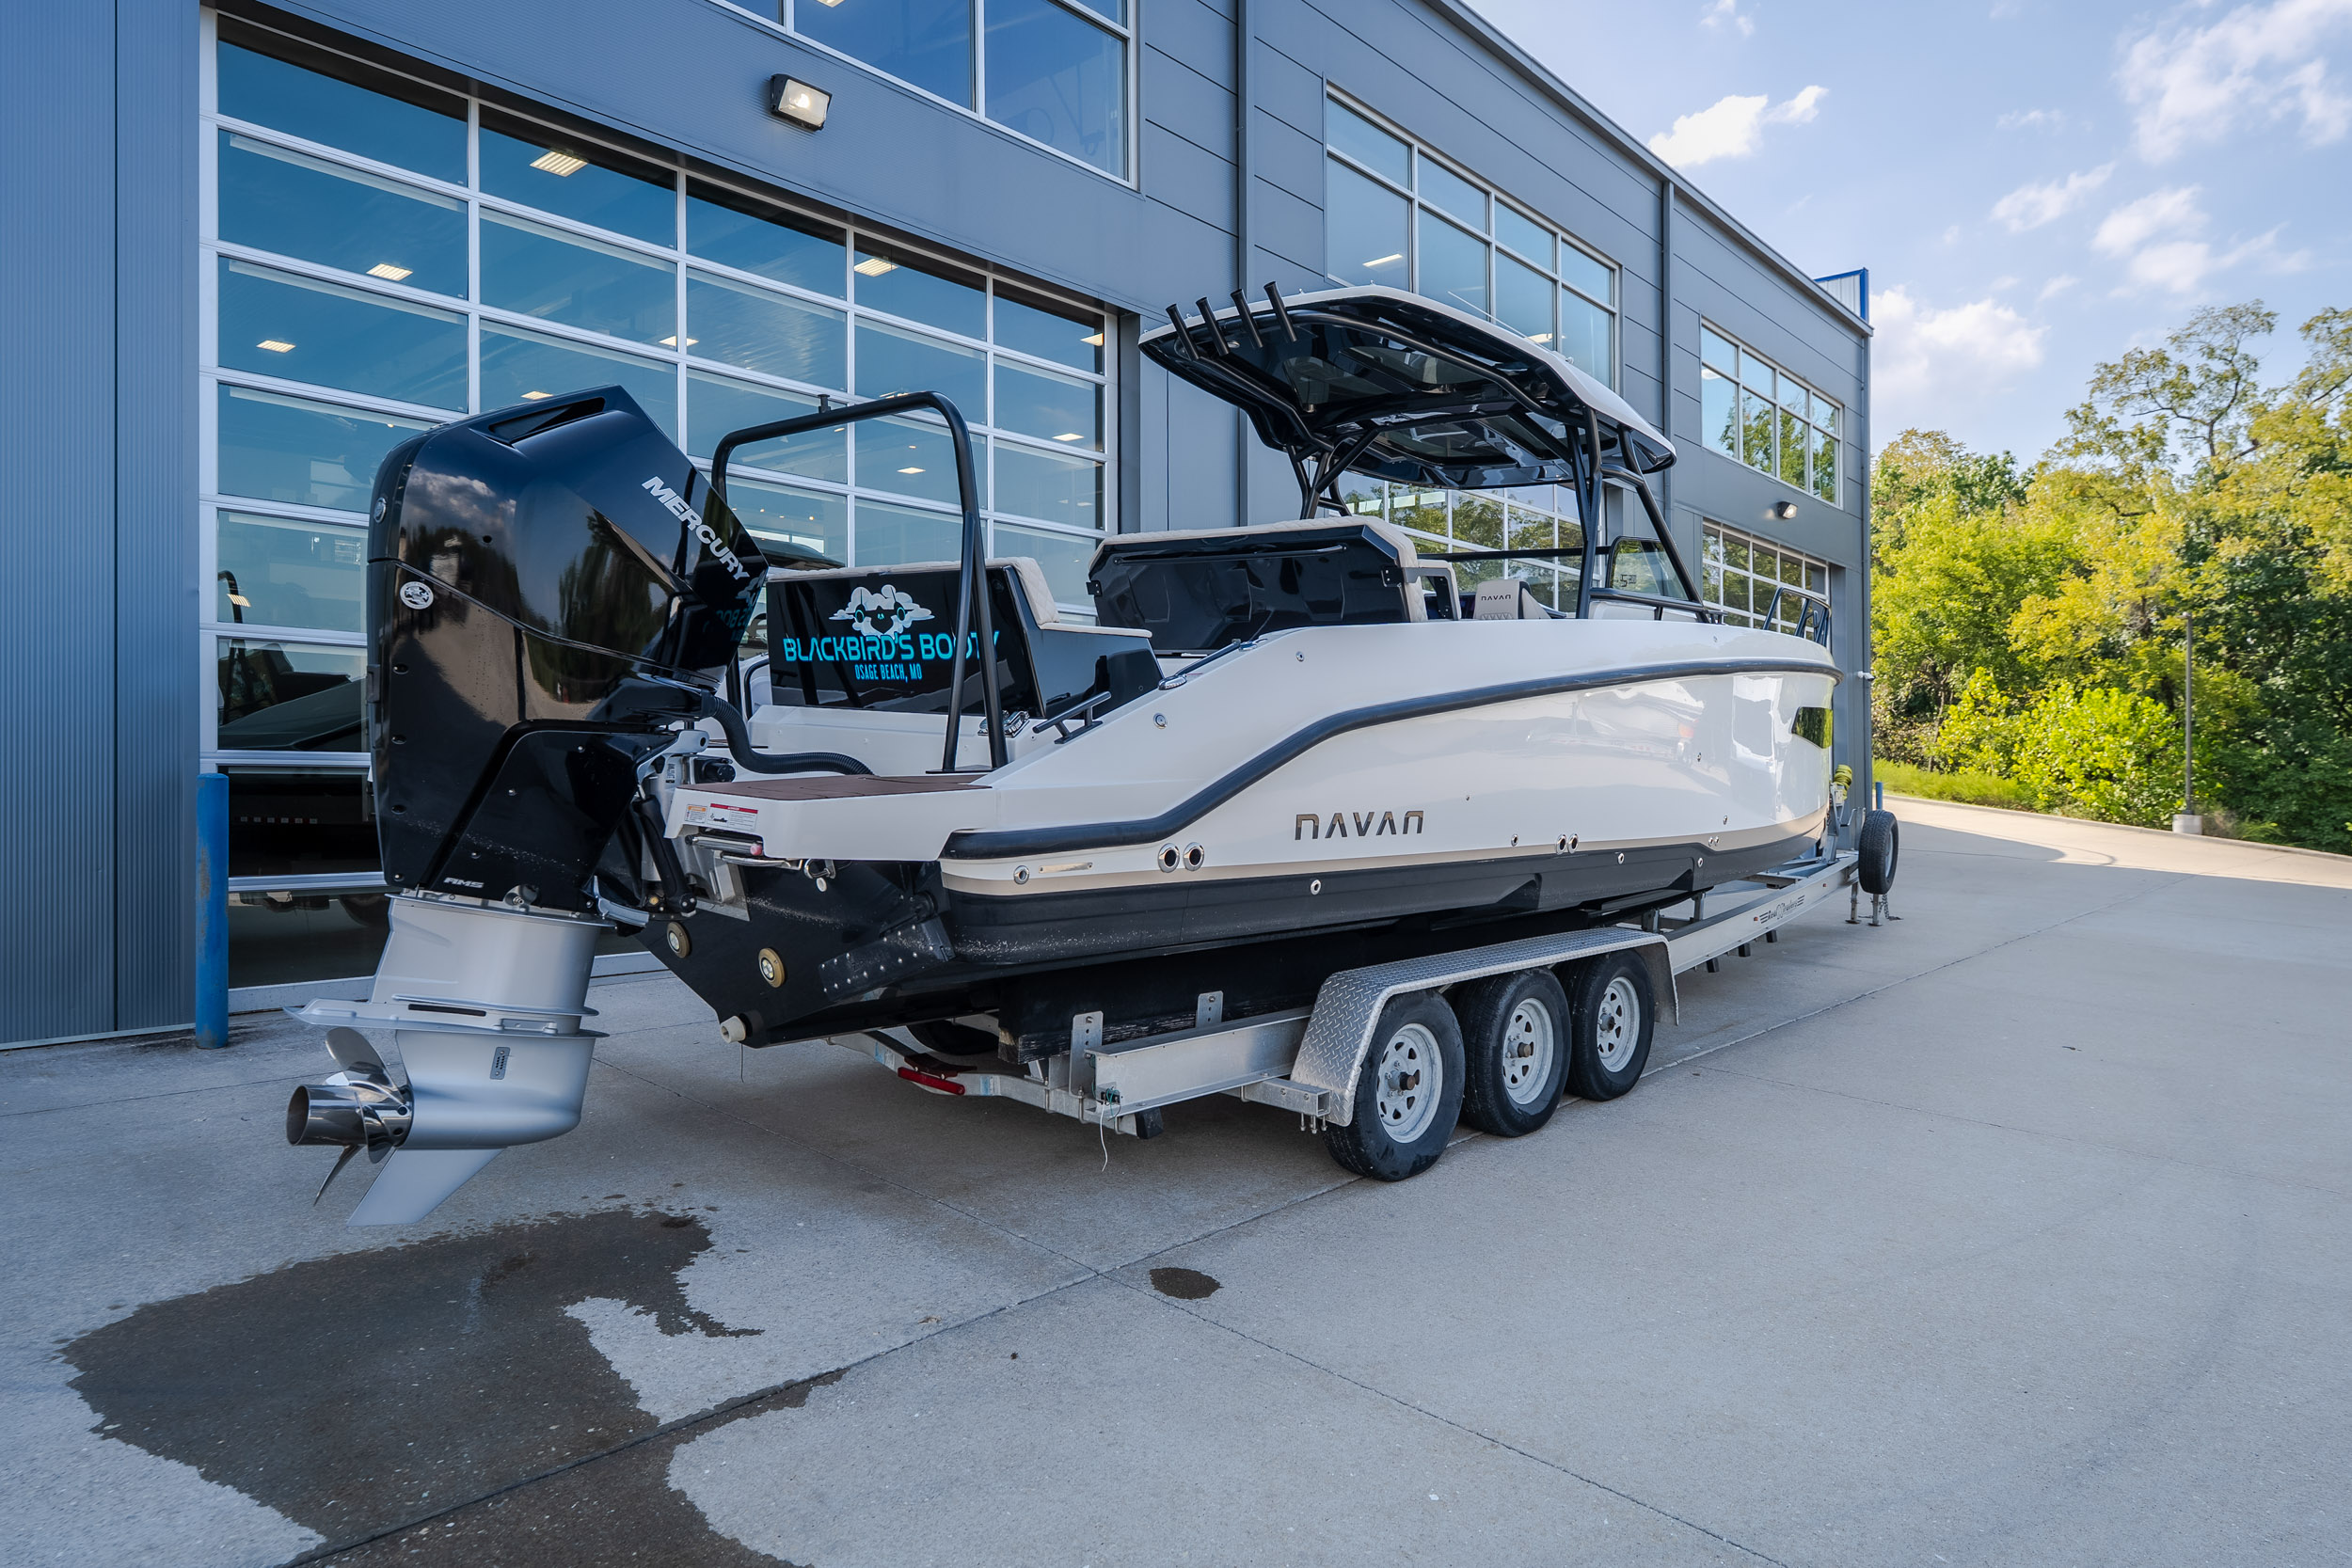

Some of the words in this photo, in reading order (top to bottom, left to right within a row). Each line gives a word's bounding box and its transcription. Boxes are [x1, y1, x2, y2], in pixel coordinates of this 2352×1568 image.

[641, 476, 751, 580] MERCURY
[783, 631, 914, 661] BLACKBIRD'S
[854, 663, 879, 680] OSAGE
[880, 662, 908, 683] BEACH,
[909, 662, 922, 680] MO
[1295, 810, 1423, 841] NAVAN
